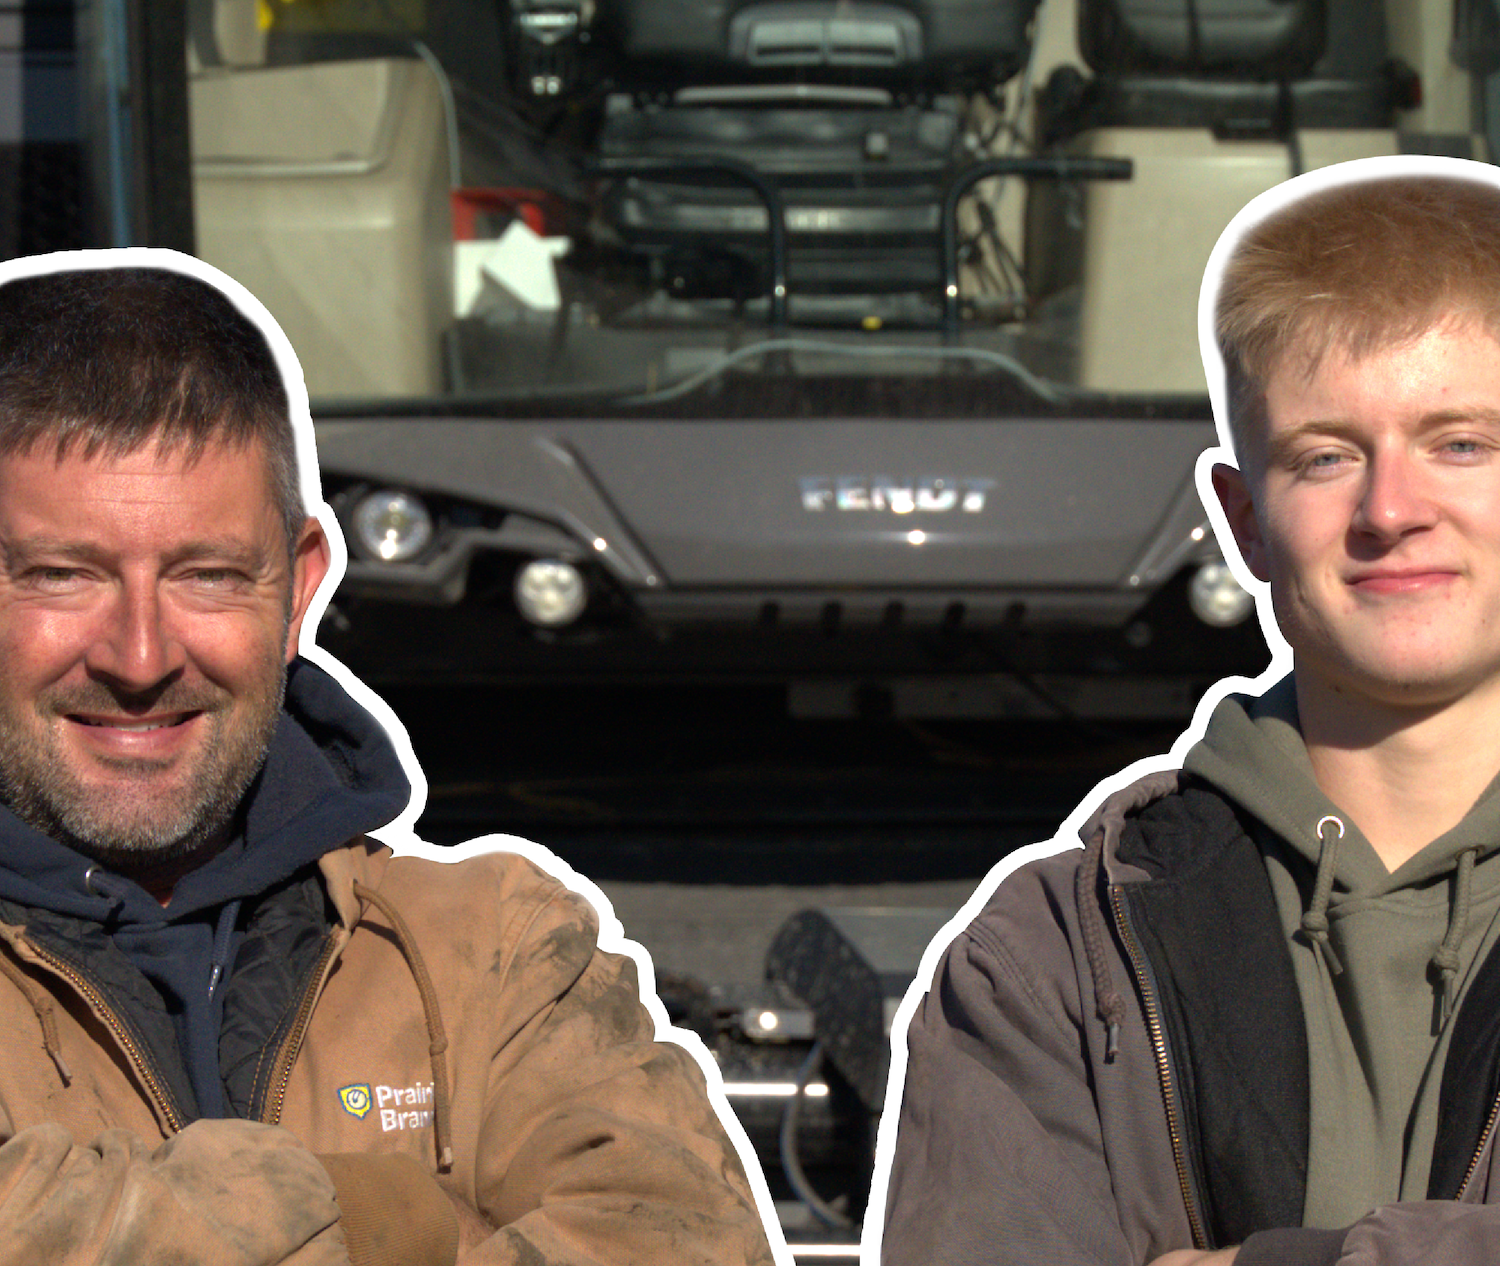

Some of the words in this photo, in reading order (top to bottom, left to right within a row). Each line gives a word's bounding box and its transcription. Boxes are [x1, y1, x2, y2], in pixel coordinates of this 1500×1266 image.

[799, 475, 997, 513] FENDT
[375, 1081, 434, 1108] Prairi
[380, 1108, 434, 1132] Bran
